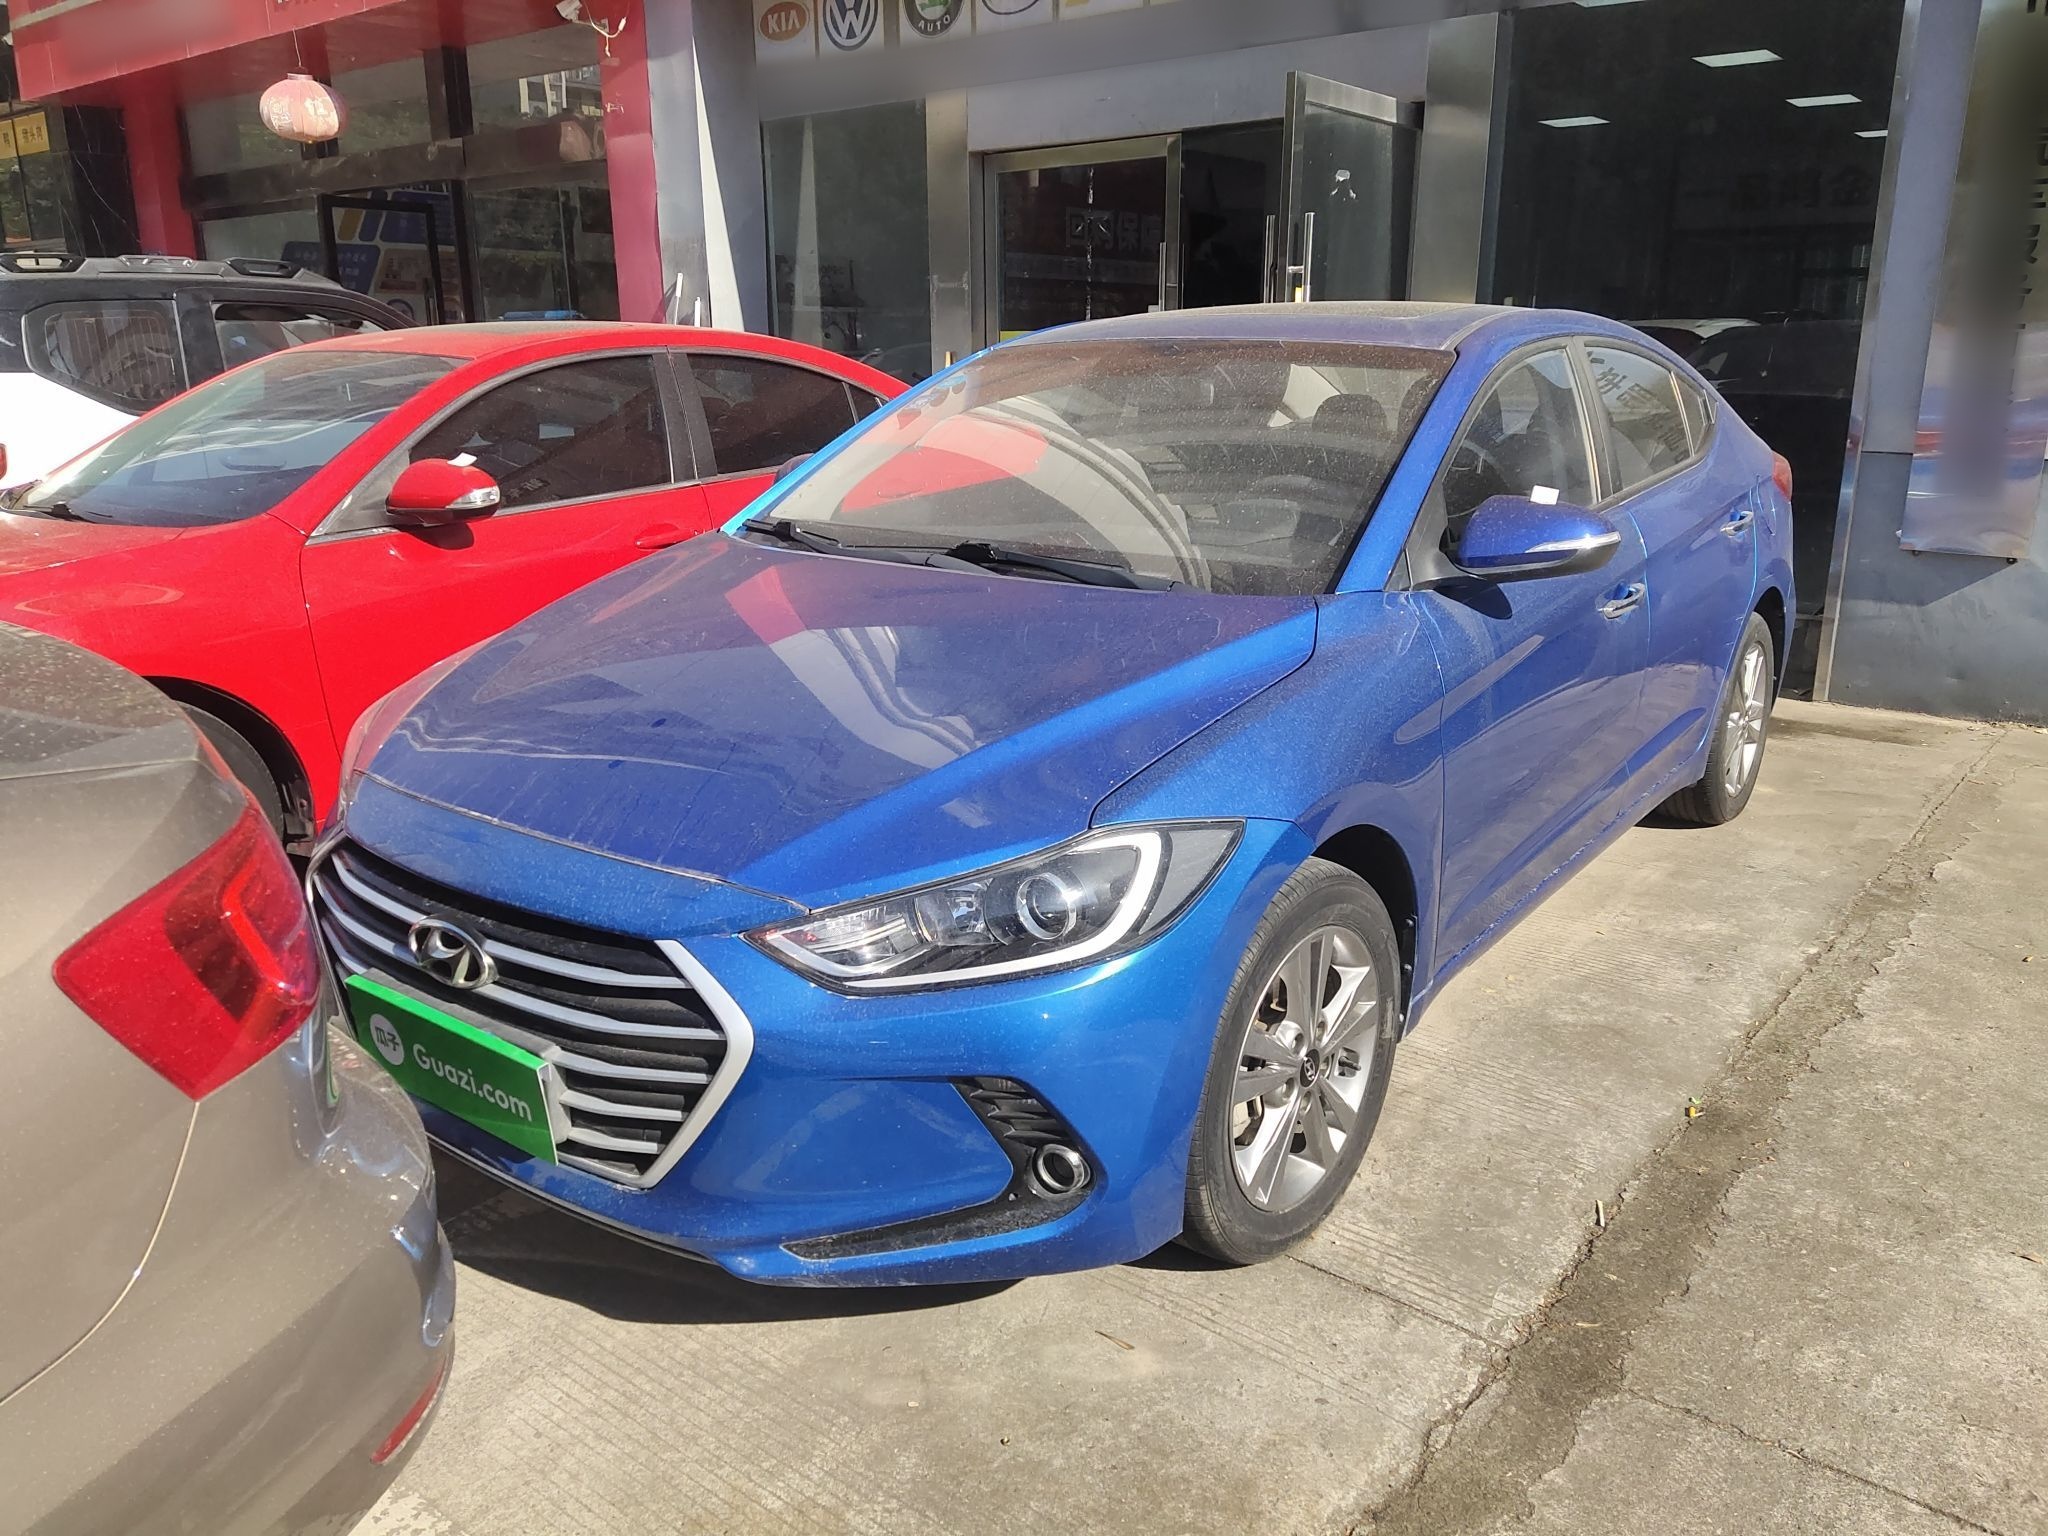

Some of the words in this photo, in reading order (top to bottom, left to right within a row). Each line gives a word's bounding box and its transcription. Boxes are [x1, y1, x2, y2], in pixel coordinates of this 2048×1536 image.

[767, 10, 800, 34] KIA
[918, 14, 950, 32] AUTO
[375, 1027, 400, 1052] 瓜子
[412, 1043, 532, 1122] Guazi.com
